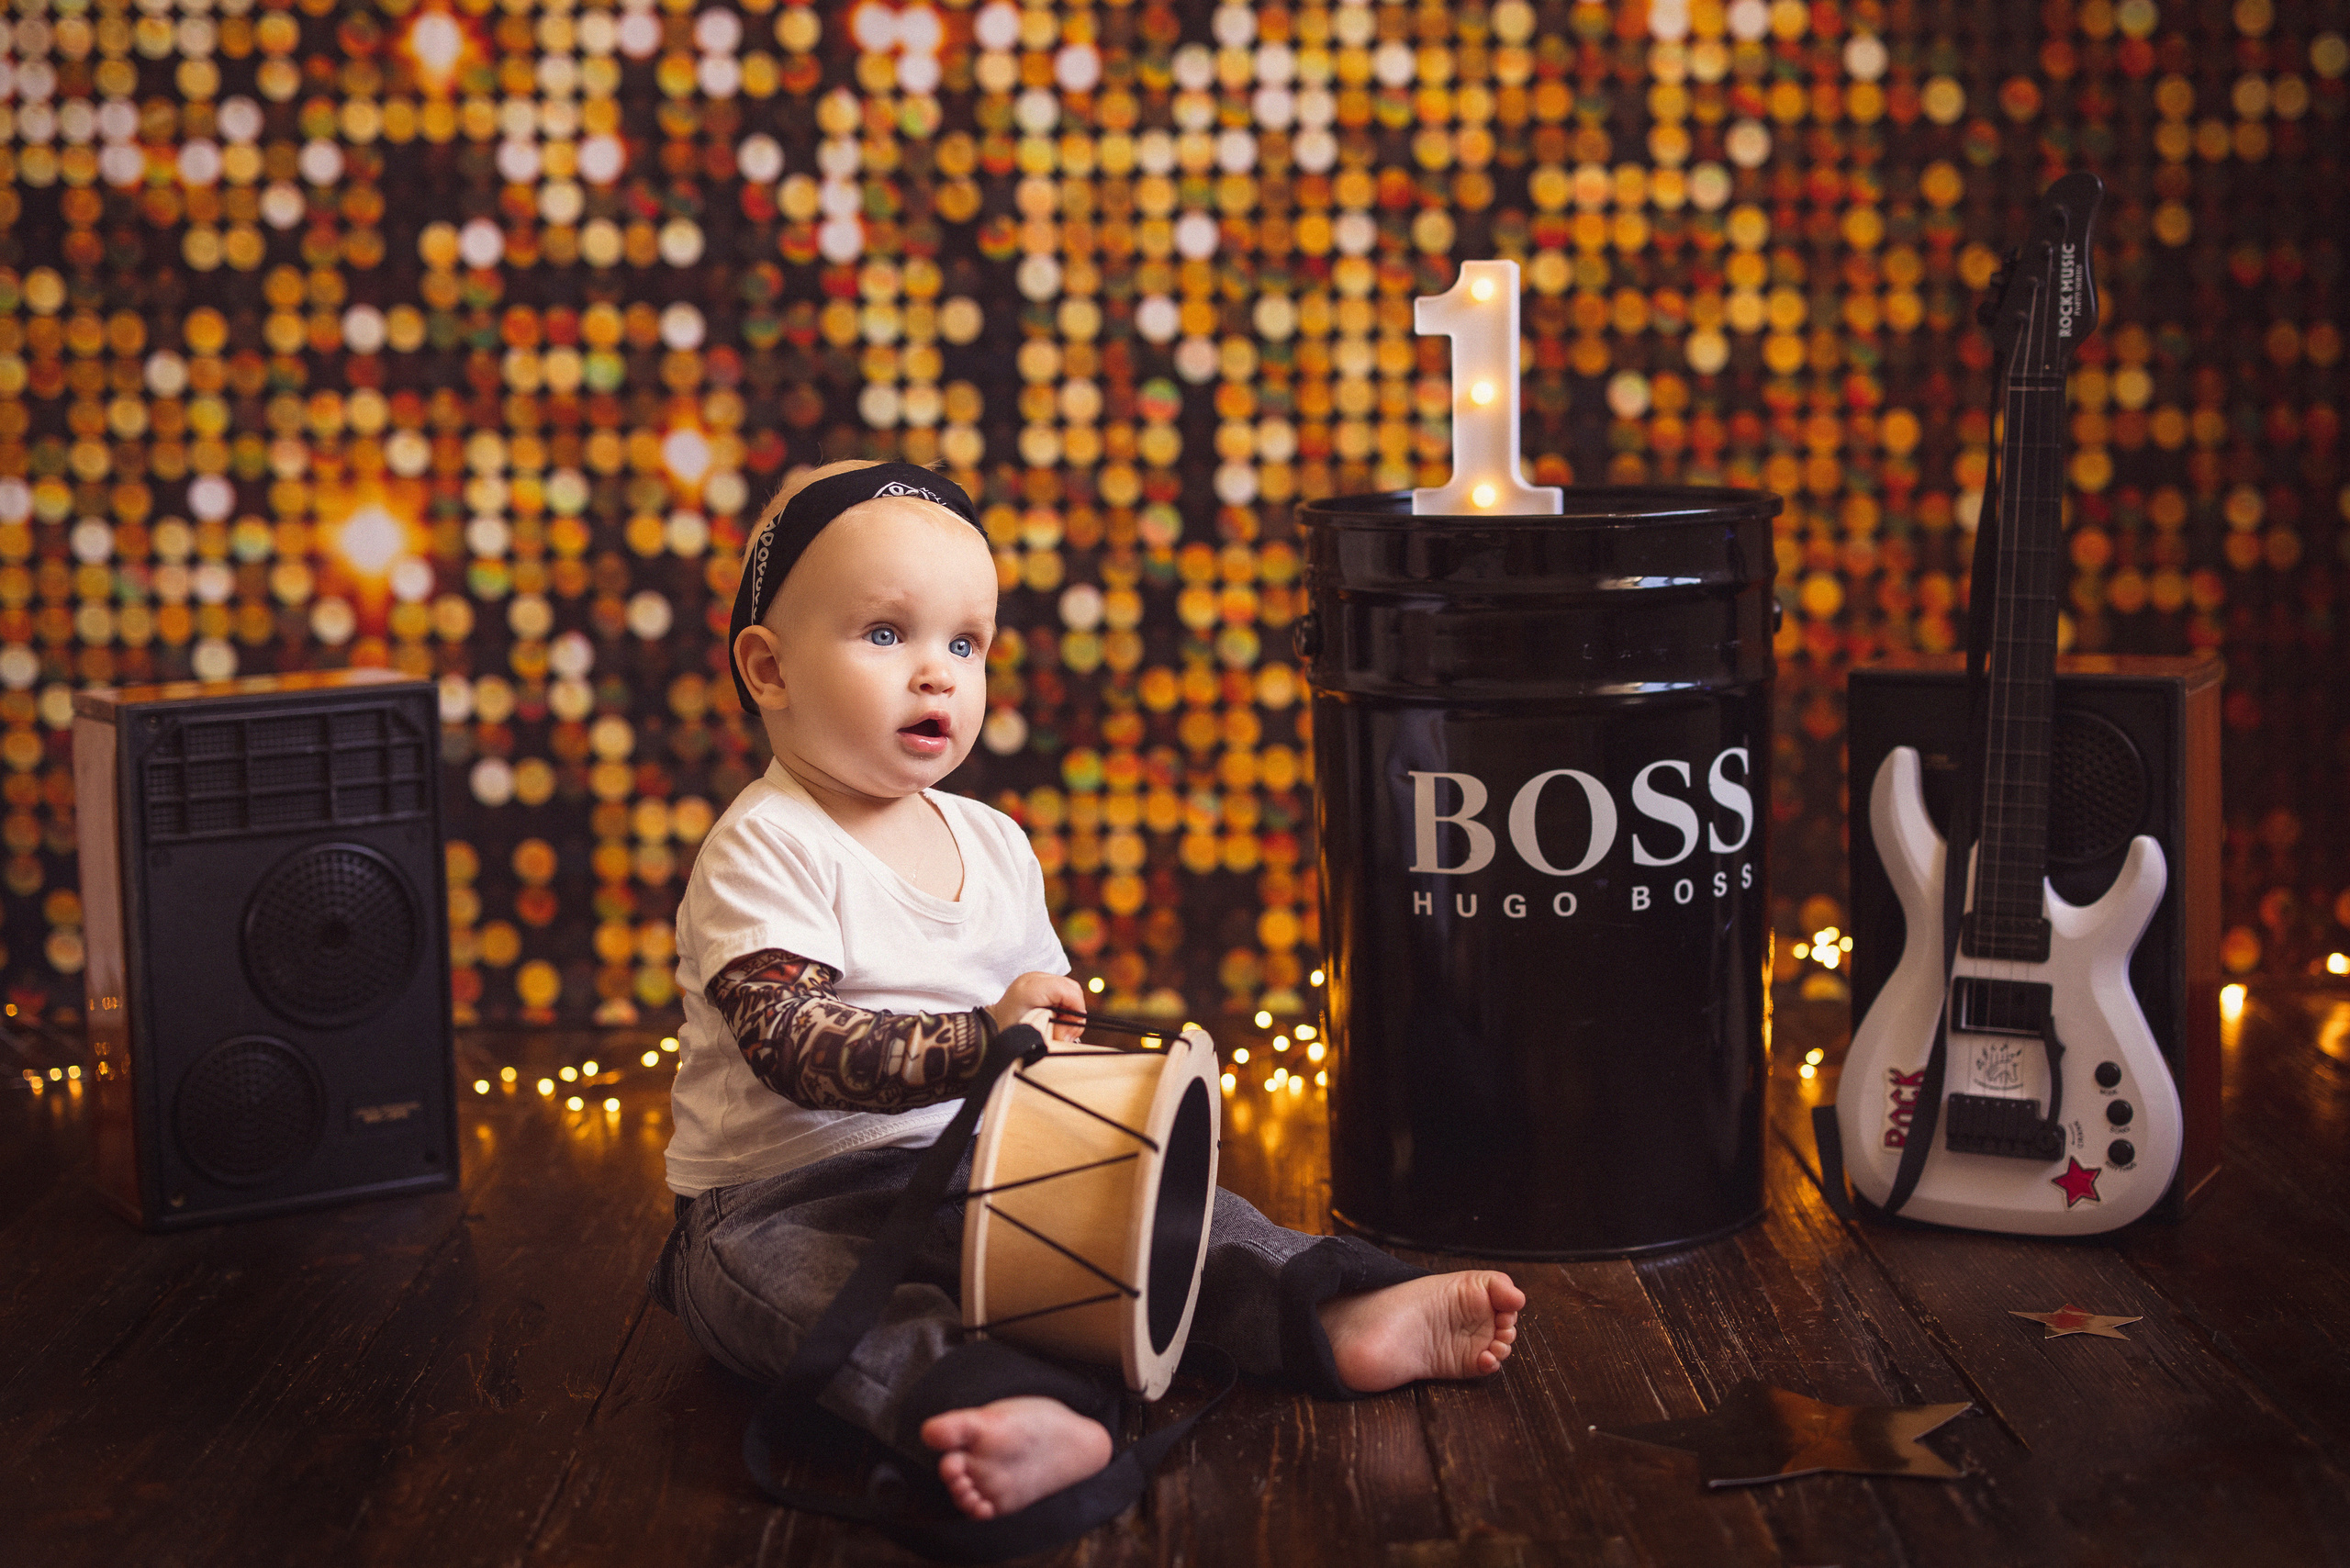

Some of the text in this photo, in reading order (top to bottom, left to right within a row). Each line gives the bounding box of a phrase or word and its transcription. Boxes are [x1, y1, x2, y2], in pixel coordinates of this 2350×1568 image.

[2058, 243, 2076, 338] ROCK MUSIC
[1412, 259, 1563, 516] 1
[1408, 747, 1754, 878] BOSS
[1413, 863, 1753, 919] HUGO BOSS
